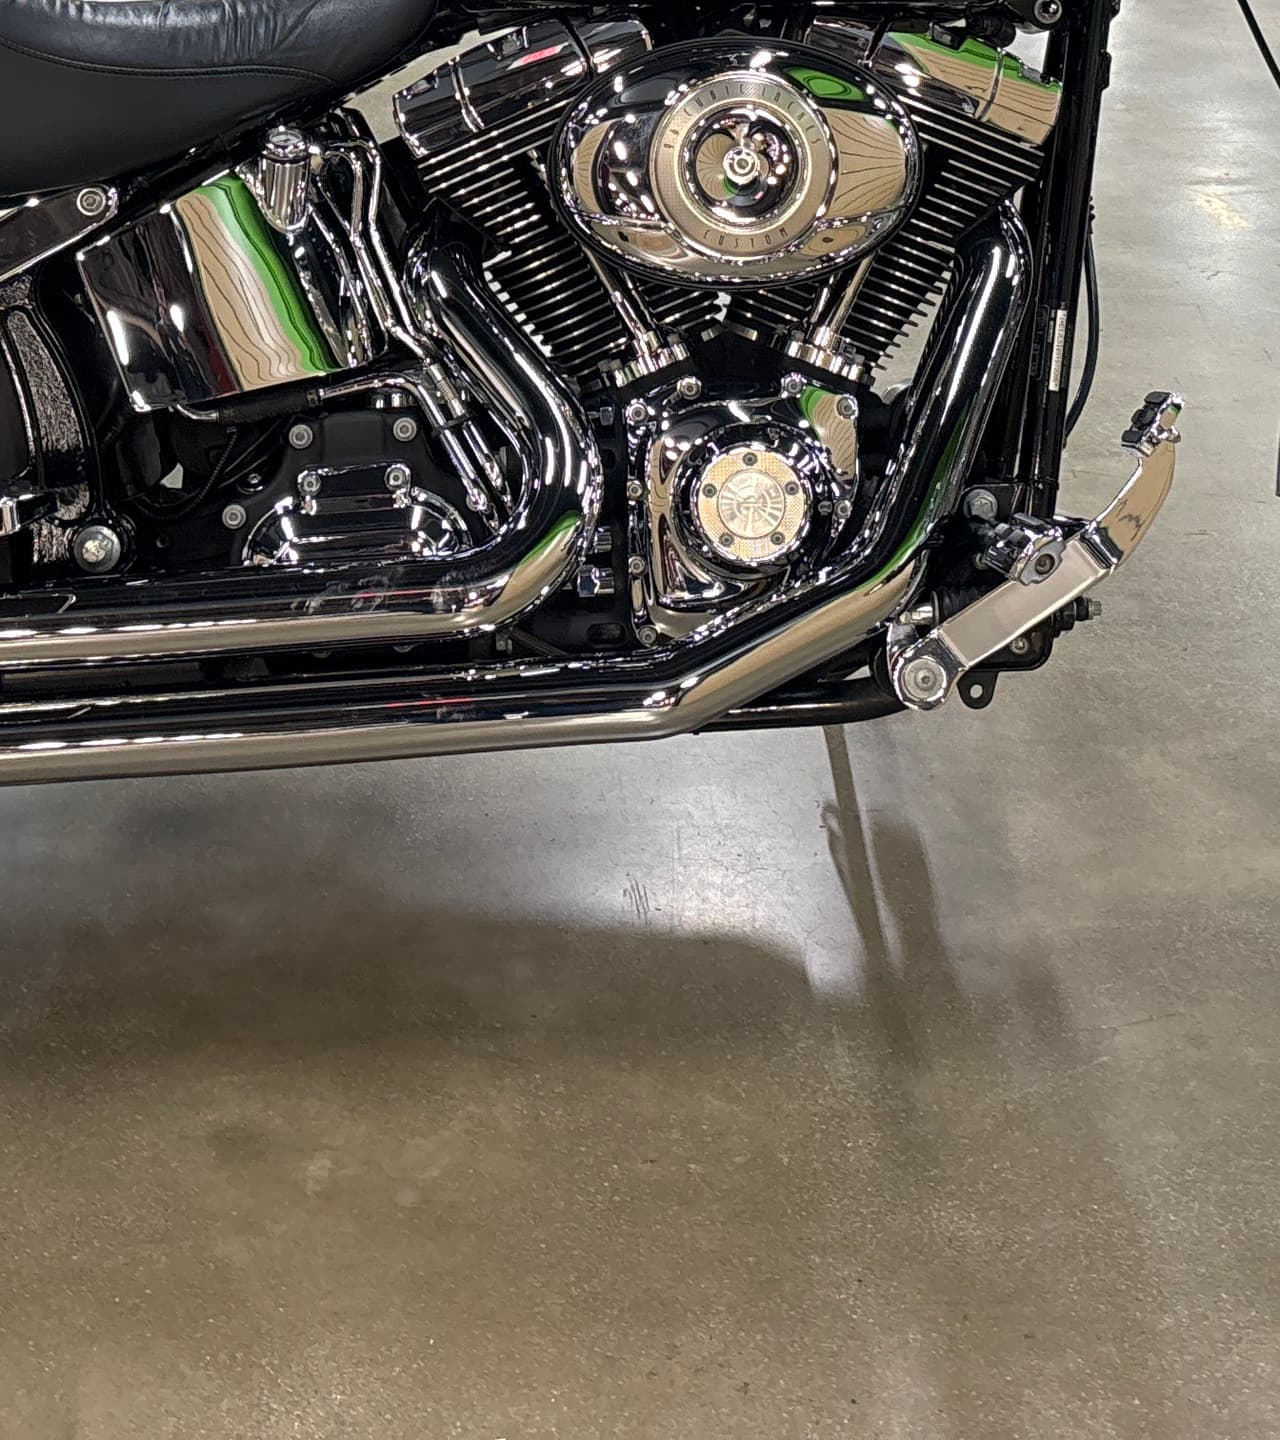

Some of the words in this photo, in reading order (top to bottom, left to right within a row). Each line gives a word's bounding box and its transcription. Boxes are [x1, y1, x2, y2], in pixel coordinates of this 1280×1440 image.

[683, 84, 745, 117] CUBIC
[761, 85, 821, 144] INCHES
[703, 226, 789, 249] CUSTOM
